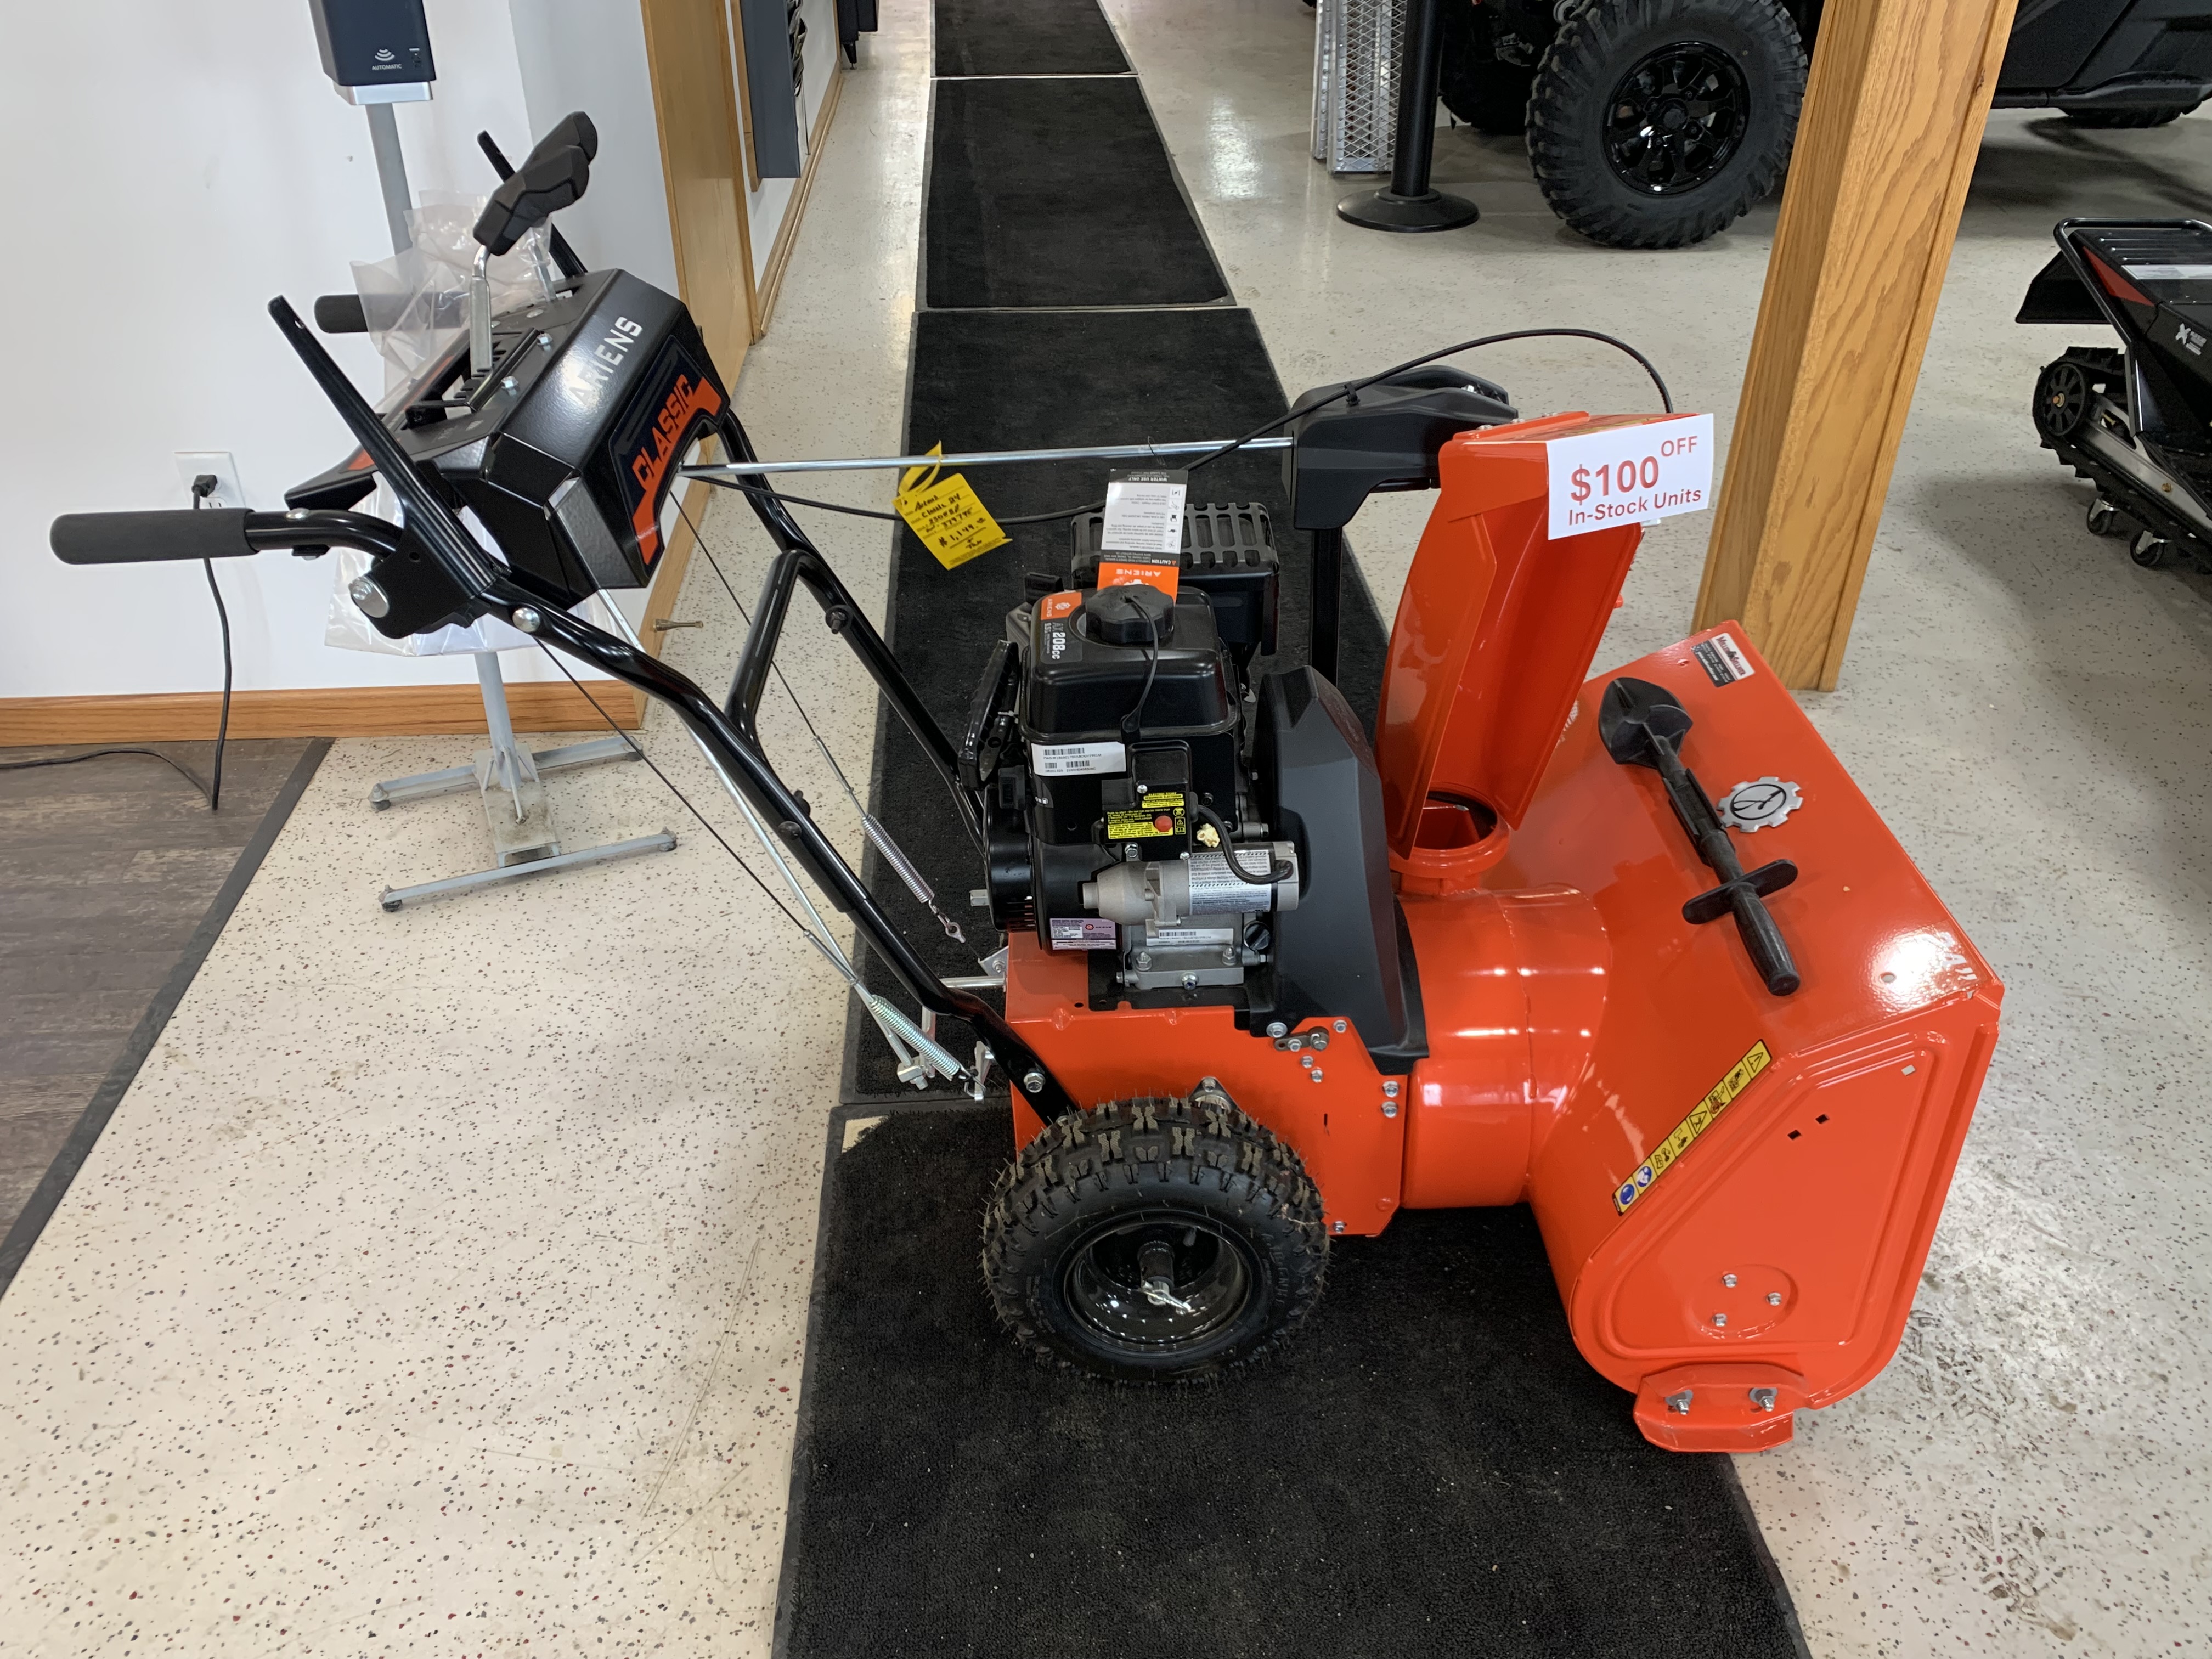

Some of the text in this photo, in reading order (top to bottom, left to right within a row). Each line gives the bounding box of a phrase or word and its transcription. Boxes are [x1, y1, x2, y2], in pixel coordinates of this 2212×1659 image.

[567, 315, 643, 405] ARIENS
[632, 374, 691, 492] CLASSIC
[1661, 436, 1697, 457] OFF
[1570, 456, 1659, 506] $100
[1568, 488, 1701, 526] In-Stock Units
[1115, 568, 1161, 577] ARIENS
[1052, 622, 1066, 659] AX 208cc
